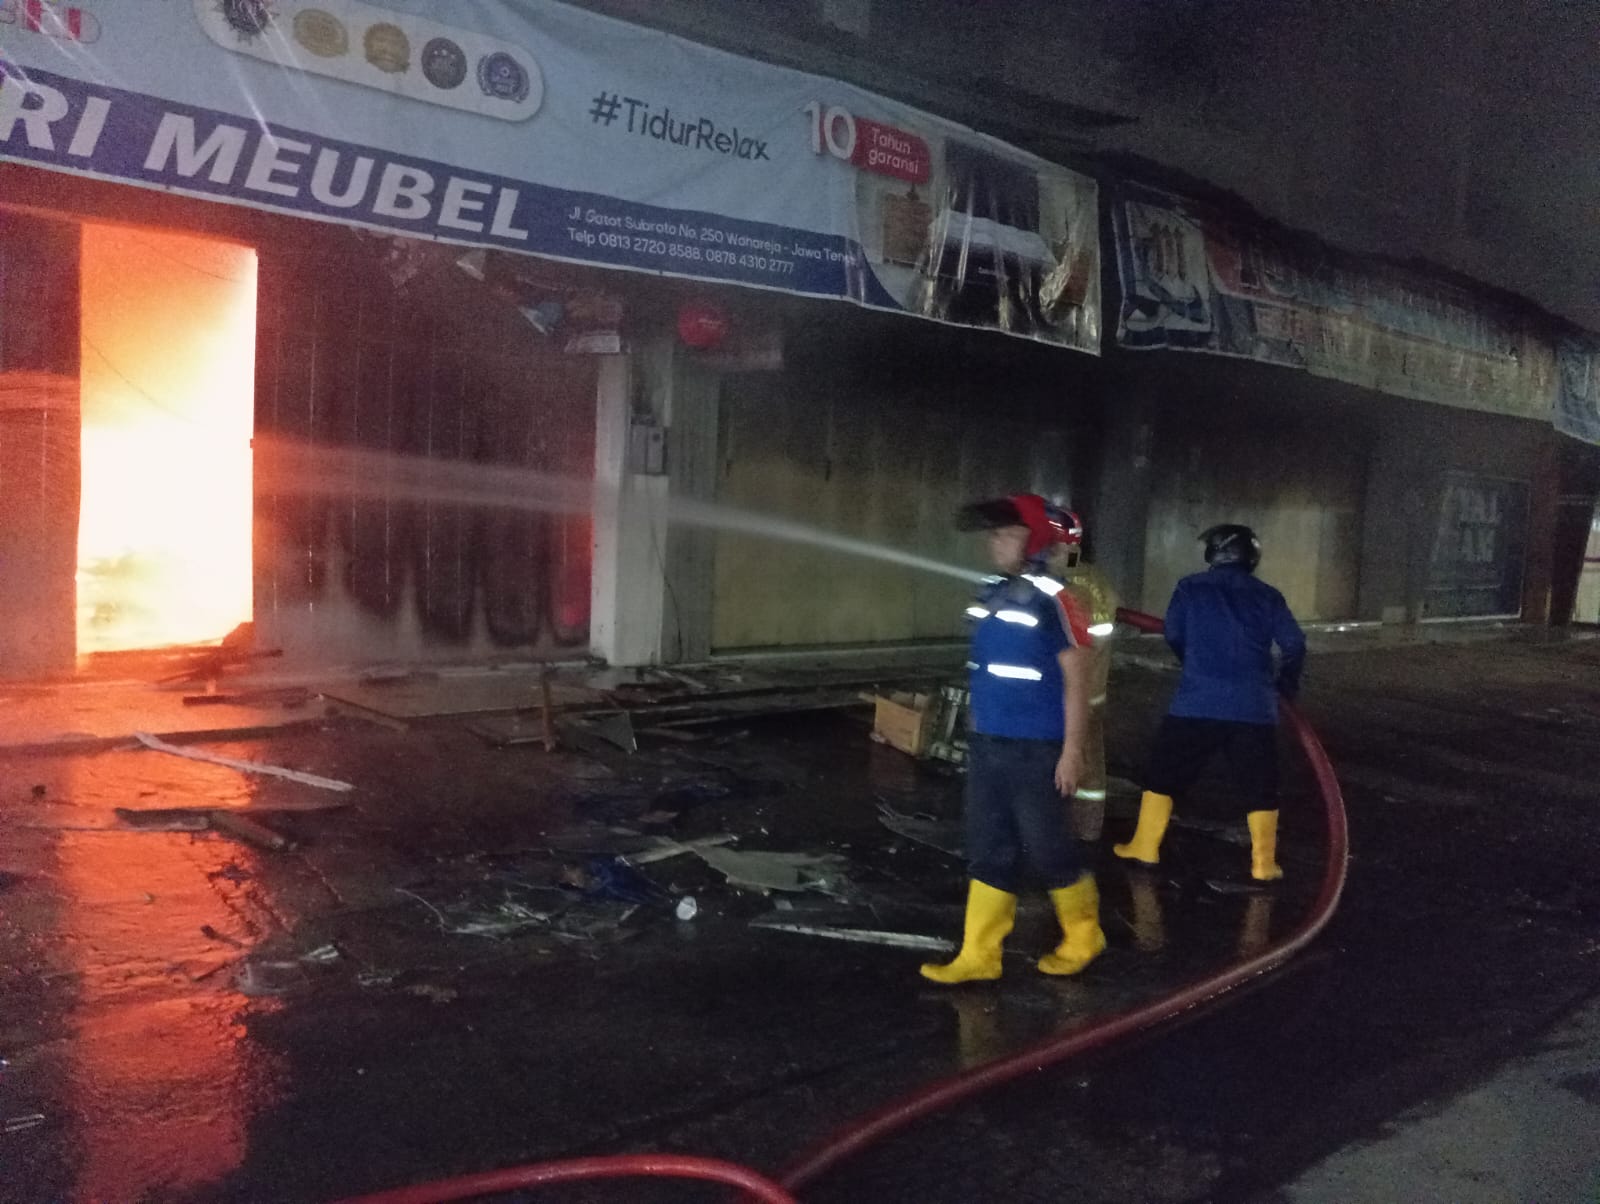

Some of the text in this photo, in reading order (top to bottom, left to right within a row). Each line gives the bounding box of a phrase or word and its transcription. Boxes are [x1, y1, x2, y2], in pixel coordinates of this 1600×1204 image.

[589, 91, 770, 161] #TidurRelax
[804, 101, 857, 160] 10
[871, 126, 911, 154] Tahun
[143, 111, 529, 240] MEUBEL
[868, 148, 920, 174] garansi
[567, 226, 596, 247] Telp
[598, 232, 631, 250] 0813
[633, 239, 666, 255] 2720
[705, 250, 737, 265] 0878
[739, 257, 767, 270] 4310
[769, 258, 794, 274] 2777
[585, 209, 621, 227] Gatot
[625, 216, 676, 235] Subroto
[700, 228, 724, 243] 250
[726, 231, 782, 254] Wanareja
[791, 245, 822, 260] Jawa
